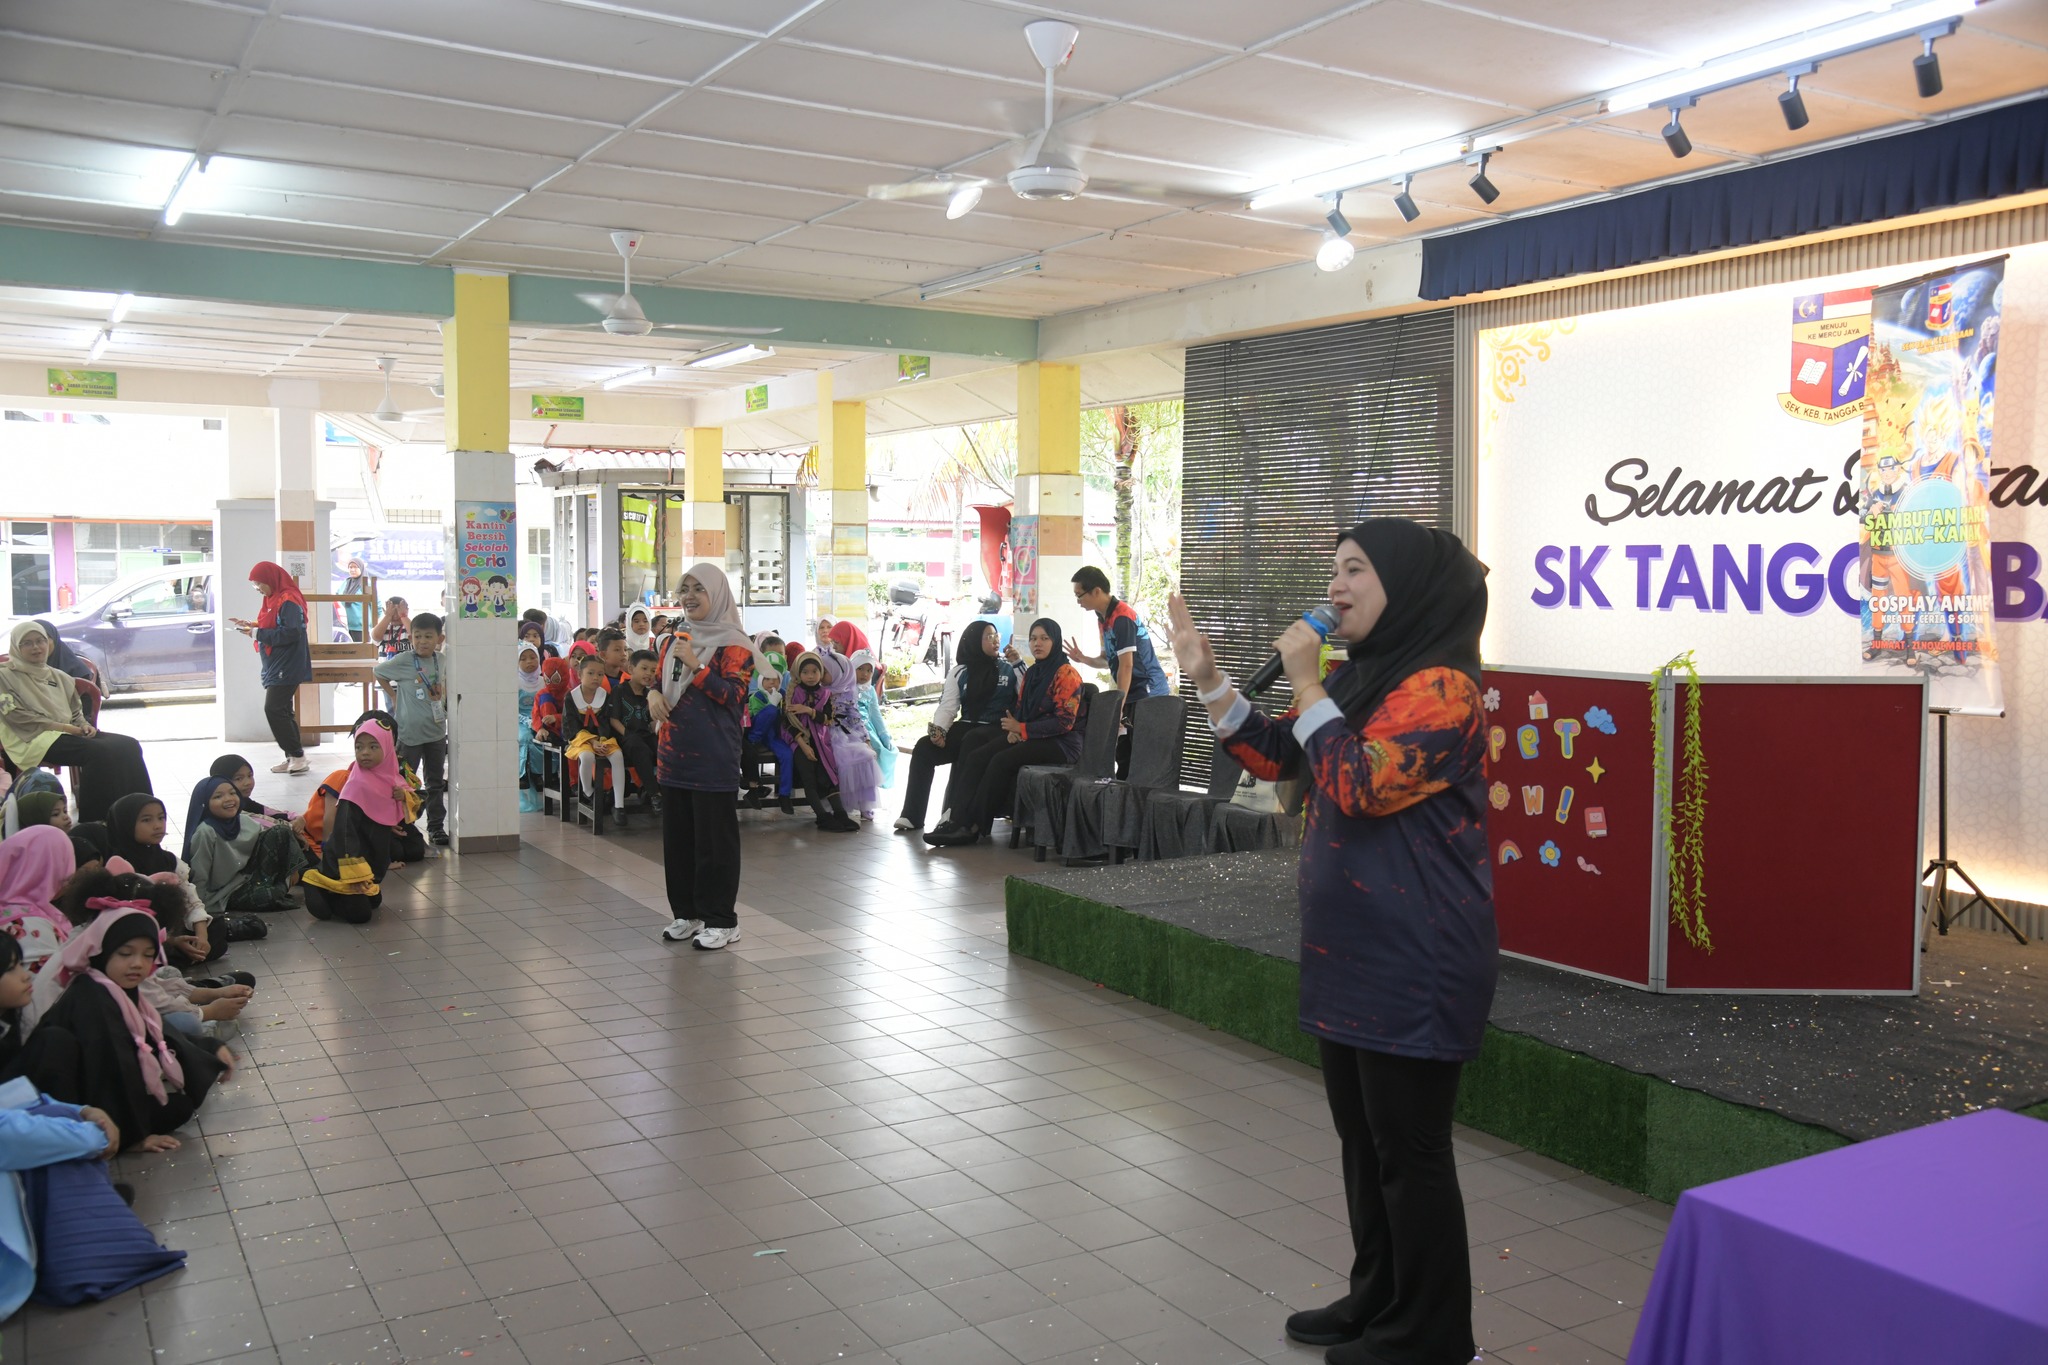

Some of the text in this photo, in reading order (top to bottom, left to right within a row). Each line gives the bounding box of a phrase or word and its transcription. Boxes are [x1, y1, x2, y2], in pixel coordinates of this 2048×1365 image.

[1820, 322, 1848, 330] MENUJU
[1818, 330, 1842, 339] MERCU
[1844, 328, 1860, 336] JAYA
[1785, 400, 1865, 421] SEK. KEB. TANGGA B
[1585, 457, 1829, 527] Selamat
[465, 520, 507, 531] Kantin
[1864, 507, 1958, 532] SAMBUTAN
[467, 531, 506, 541] Bersih
[1870, 523, 1981, 547] KANAK-KANAK
[464, 542, 509, 552] Sekolah
[465, 553, 507, 568] Ceria
[1531, 544, 1613, 612] SK
[1868, 594, 1990, 613] COSPLAY ANIME
[1919, 614, 1946, 625] CERIA
[1948, 614, 1956, 625] &
[1871, 640, 1906, 651] JUMAAT
[1921, 640, 1973, 651] NOVEMBER
